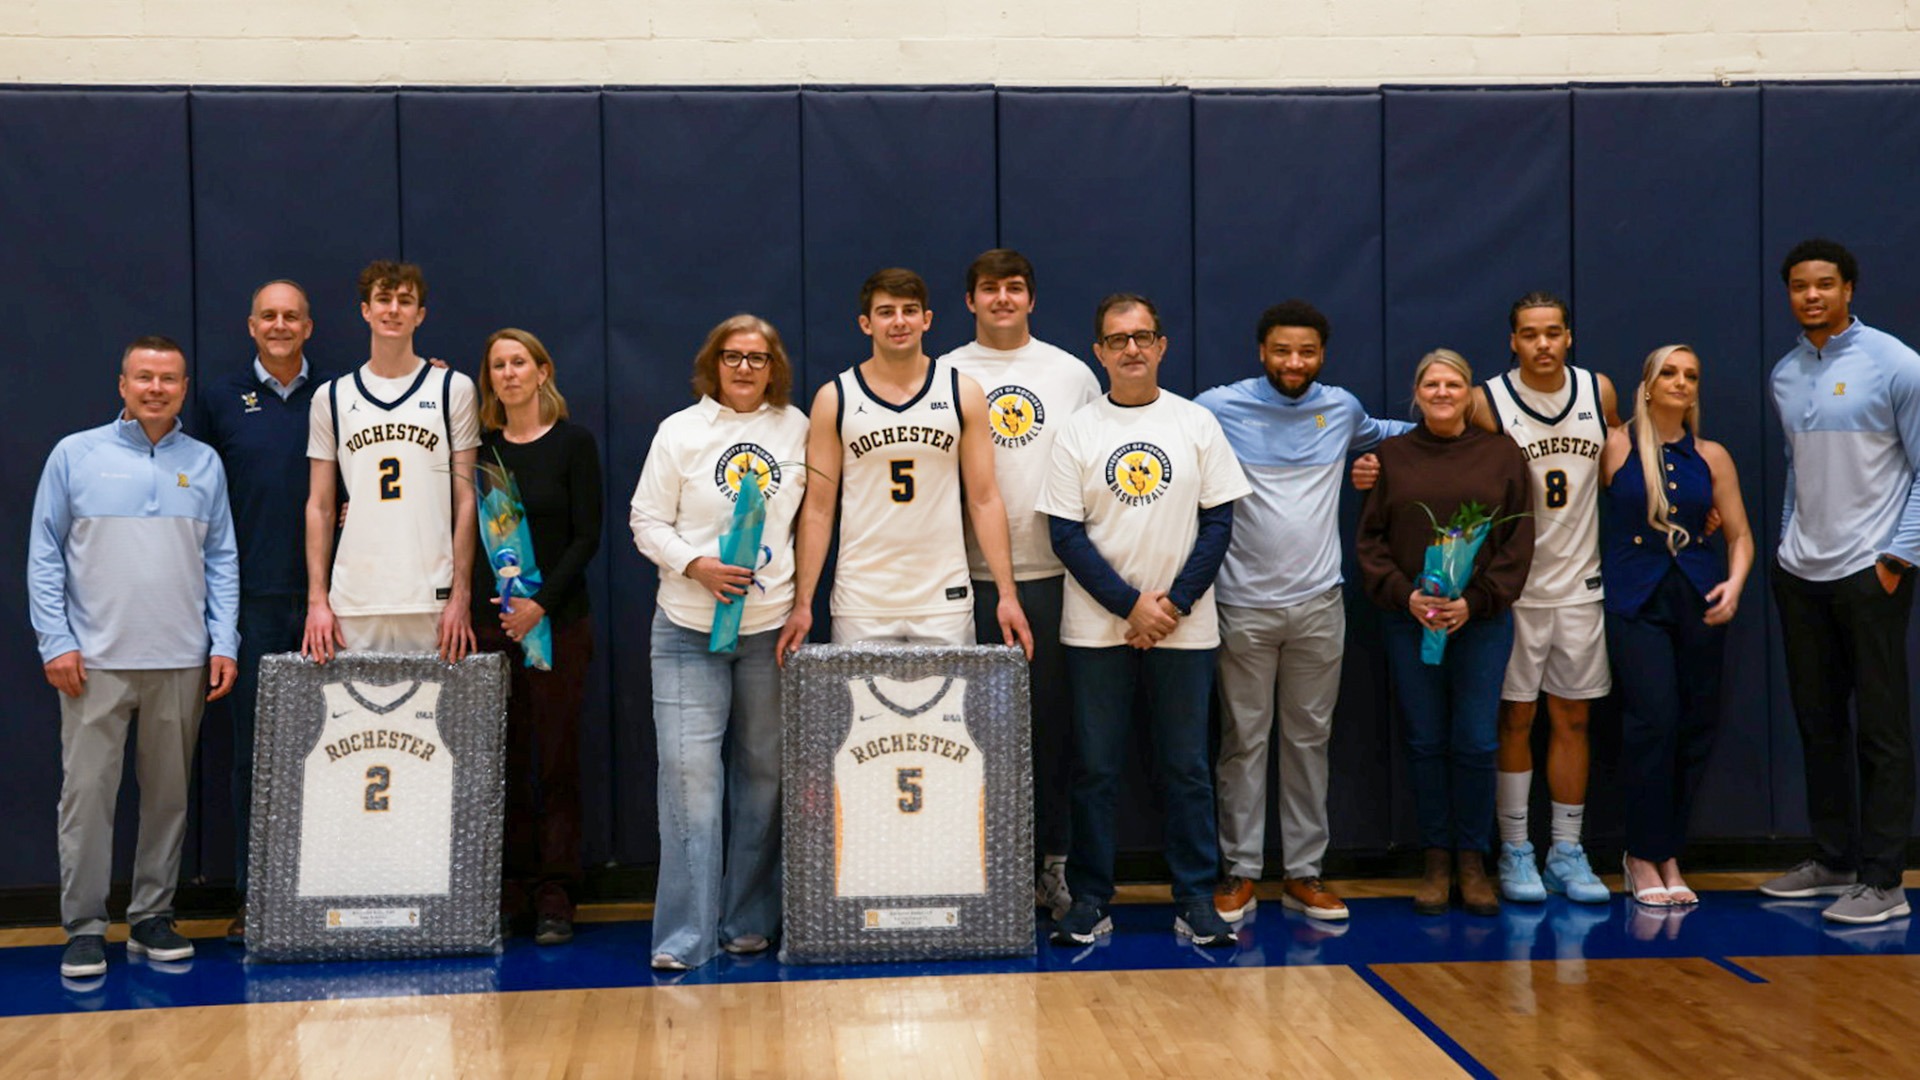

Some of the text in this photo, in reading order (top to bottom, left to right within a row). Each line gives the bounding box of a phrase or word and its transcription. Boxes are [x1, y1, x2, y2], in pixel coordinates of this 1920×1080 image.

[931, 402, 949, 410] UAA
[345, 423, 439, 455] ROCHESTER
[849, 426, 954, 459] ROCHESTER
[989, 424, 1043, 448] ASKETBALL
[1522, 437, 1600, 462] OCHESTER
[379, 456, 402, 502] 2
[720, 482, 780, 503] BASALL
[890, 459, 914, 503] 5
[1110, 482, 1169, 507] BASKETBALL
[1545, 469, 1567, 509] 8
[324, 729, 437, 763] ROCHESTER
[850, 733, 970, 765] ROCHESTER
[364, 765, 391, 812] 2
[896, 767, 924, 814] 5
